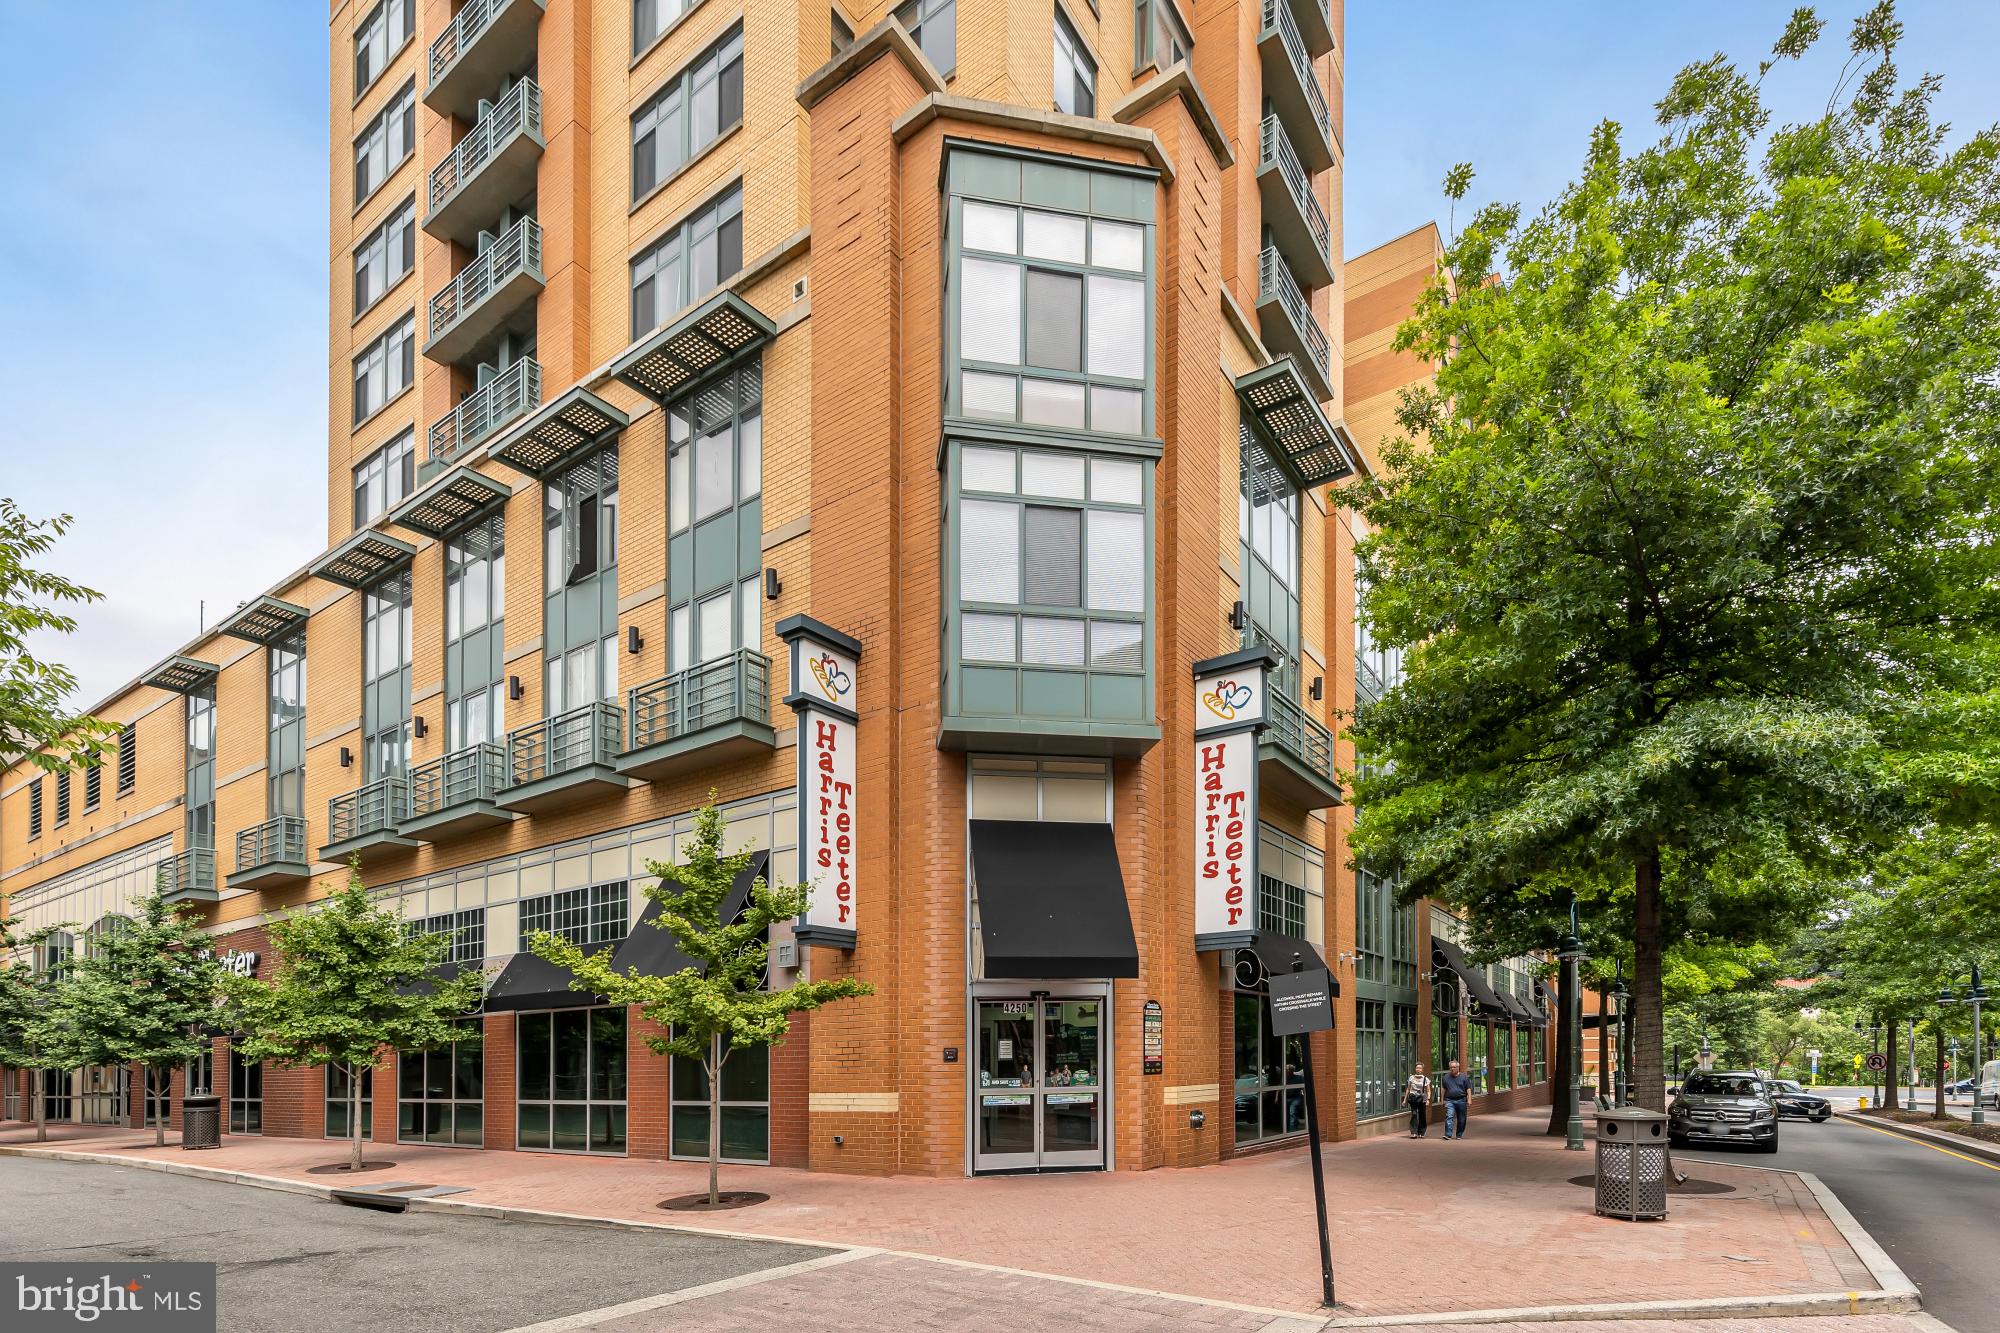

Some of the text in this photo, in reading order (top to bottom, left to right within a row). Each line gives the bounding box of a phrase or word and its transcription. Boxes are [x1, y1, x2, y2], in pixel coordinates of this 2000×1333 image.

[815, 720, 852, 924] Harris Teeter
[1201, 743, 1245, 926] Harris Teeter
[1004, 1003, 1027, 1013] 4250
